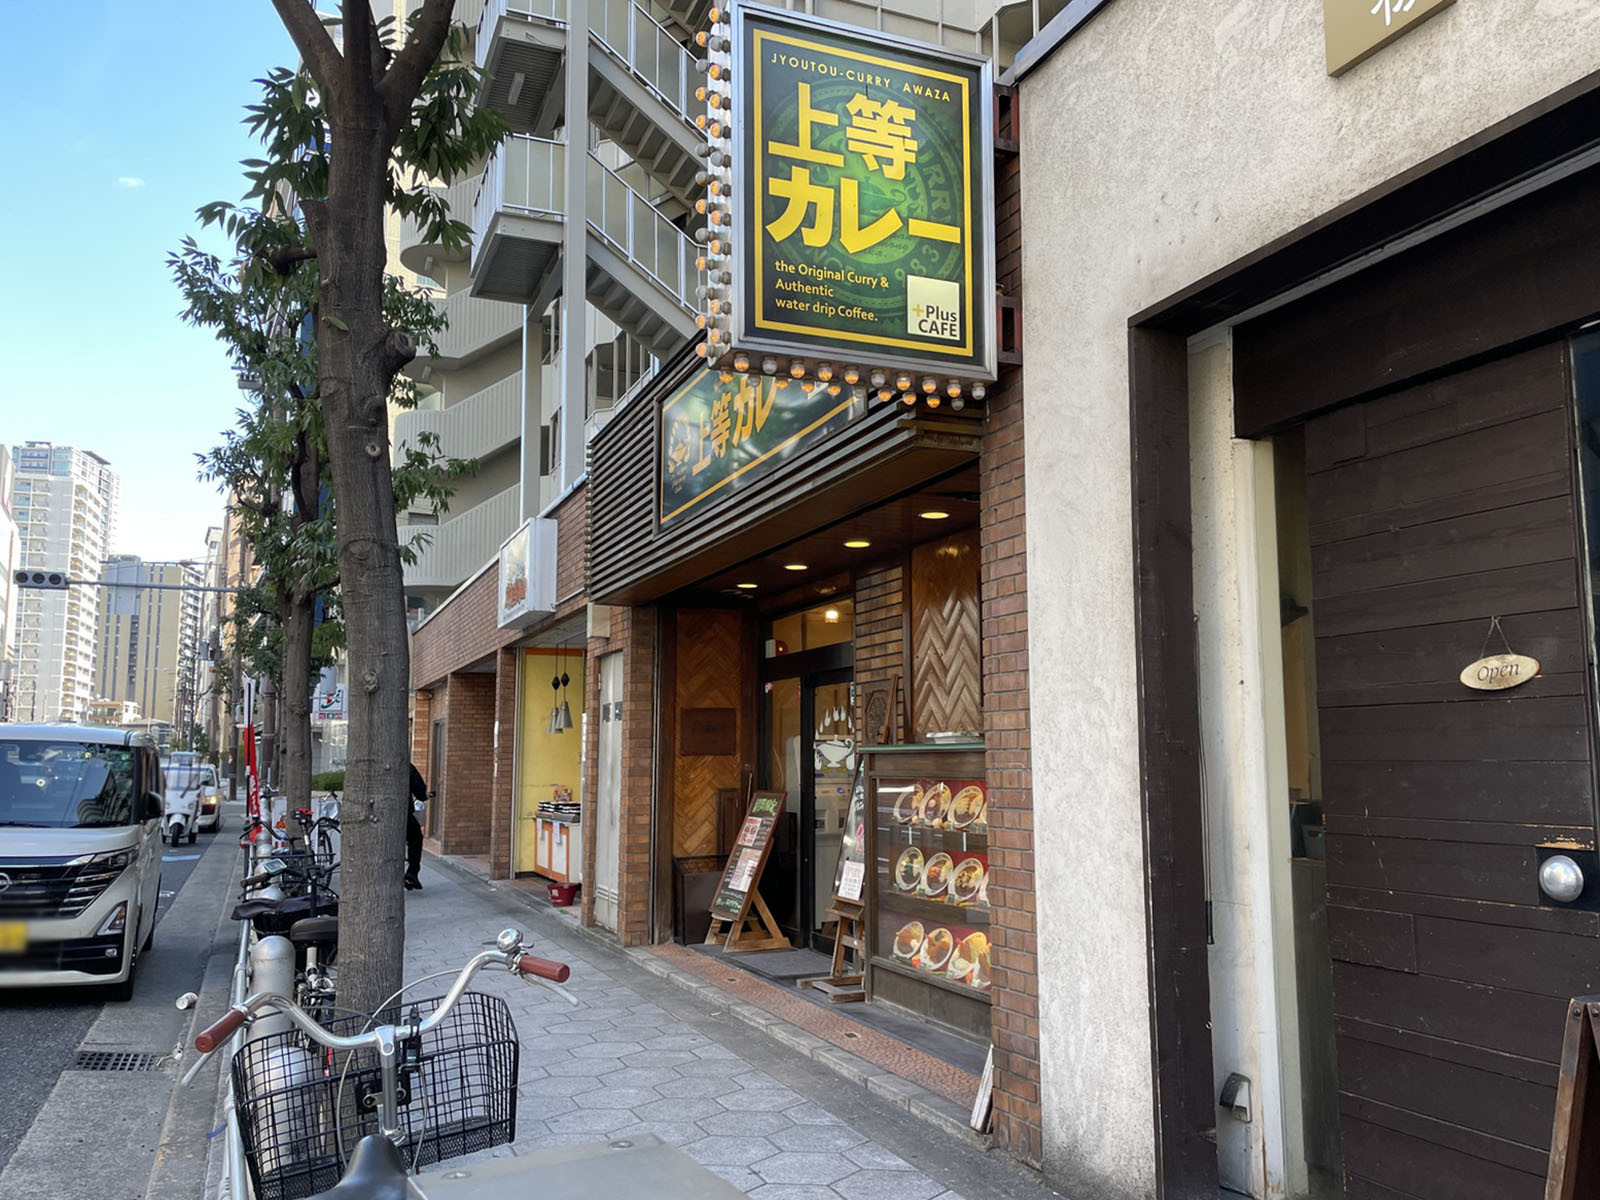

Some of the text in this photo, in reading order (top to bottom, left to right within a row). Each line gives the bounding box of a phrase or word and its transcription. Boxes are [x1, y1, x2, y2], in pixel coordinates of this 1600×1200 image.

[771, 53, 951, 102] JYOUTOU-CURRY AWAZA
[768, 82, 918, 181] 上等
[765, 166, 961, 254] カレー
[775, 260, 889, 288] the Original Curry &
[775, 278, 834, 298] Authentic
[775, 298, 879, 321] water drip Coffee.
[918, 319, 958, 338] CAFE
[692, 374, 792, 477] 上等カレ
[1477, 662, 1520, 683] Open
